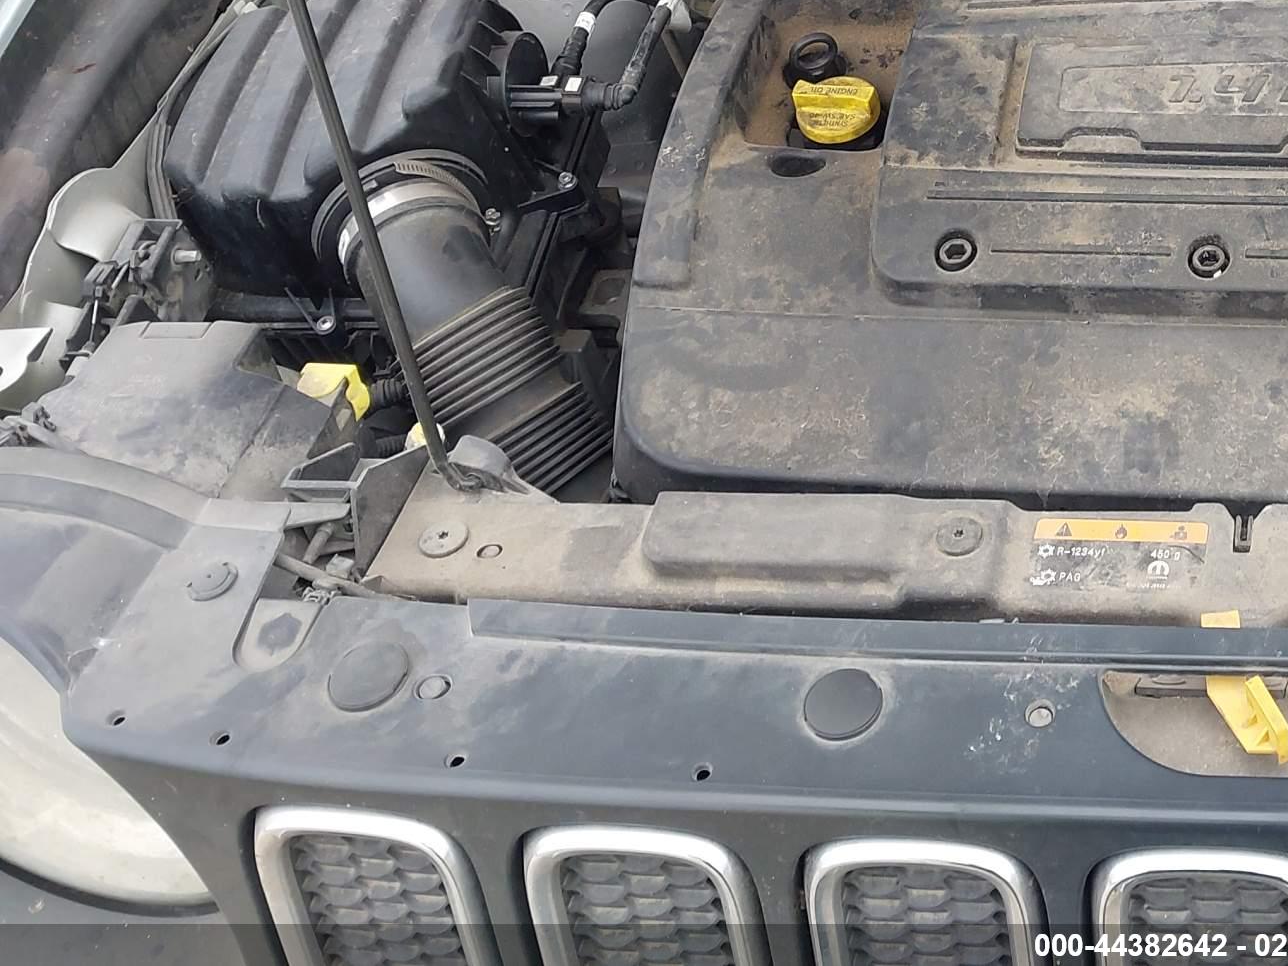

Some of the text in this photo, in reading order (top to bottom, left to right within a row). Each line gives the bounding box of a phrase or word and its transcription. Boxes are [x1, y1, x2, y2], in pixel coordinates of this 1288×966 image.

[810, 86, 858, 96] ENGINE OIL
[1057, 546, 1106, 559] R-1234yf
[1150, 549, 1170, 559] 450
